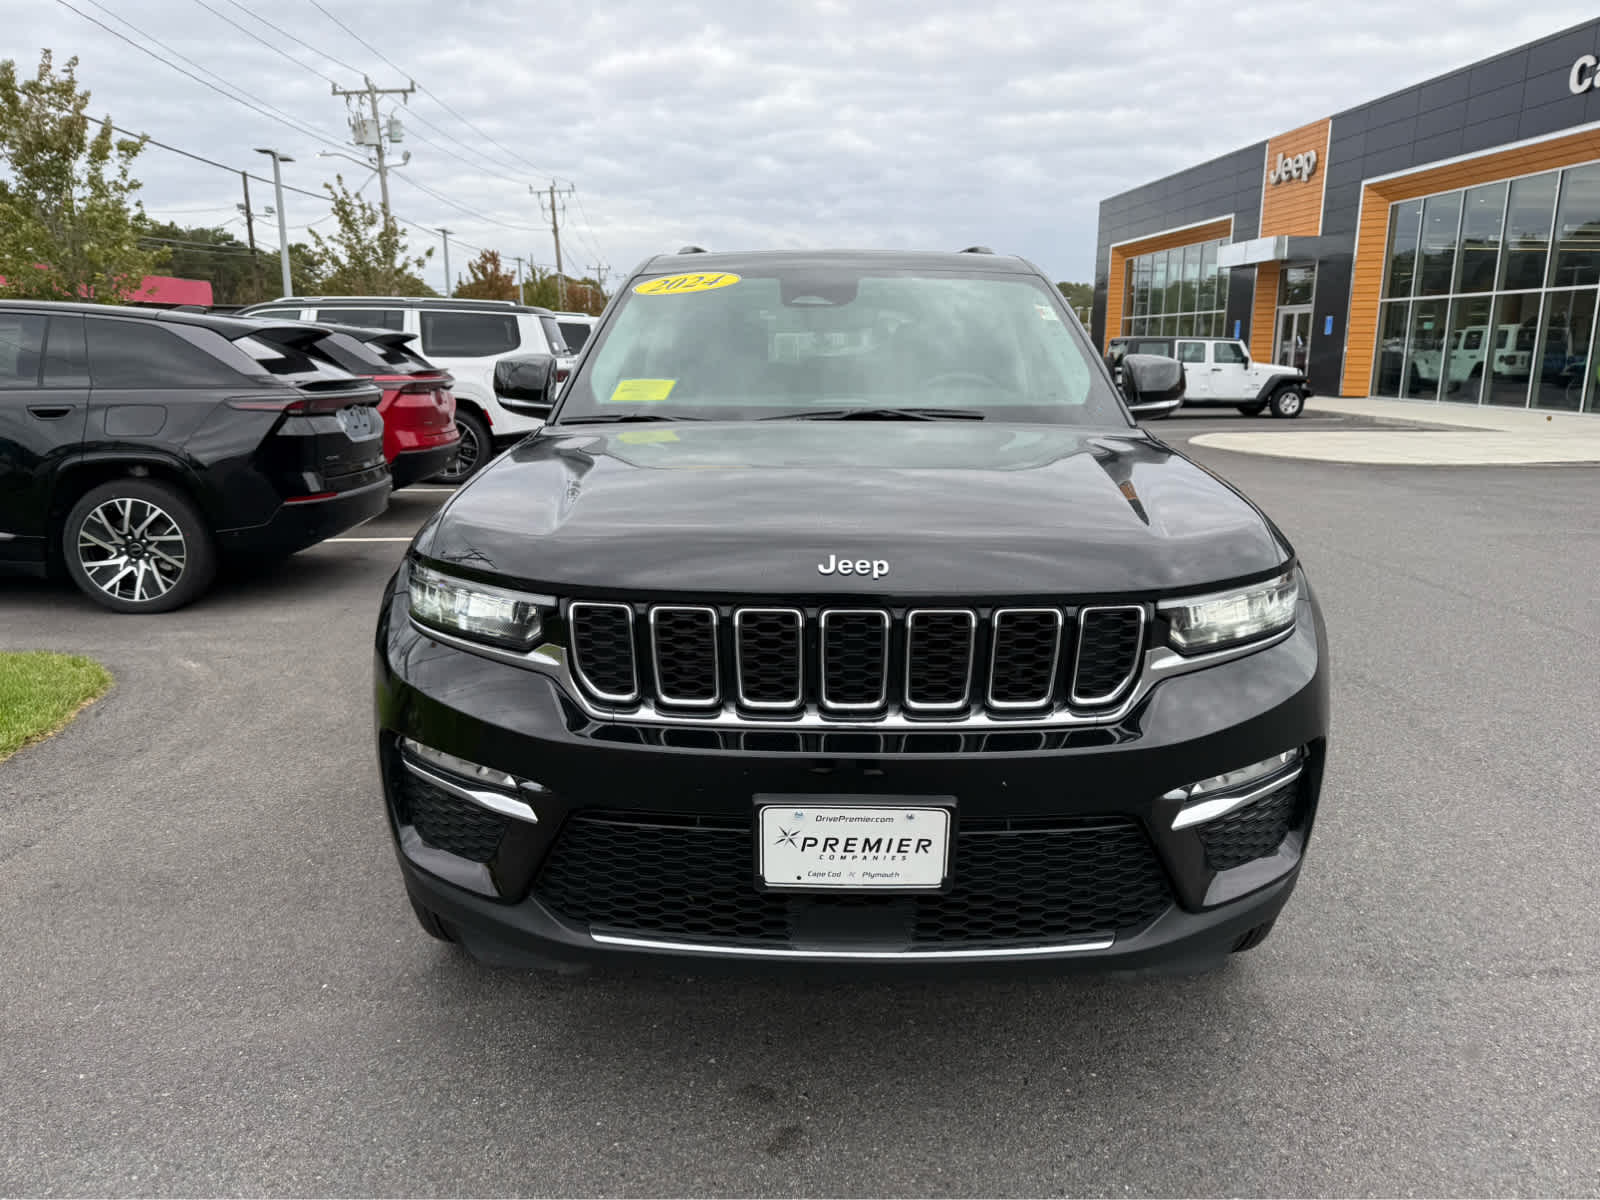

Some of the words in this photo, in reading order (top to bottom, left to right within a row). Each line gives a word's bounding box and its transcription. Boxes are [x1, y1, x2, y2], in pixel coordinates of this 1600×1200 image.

[1269, 149, 1317, 185] Jeep
[646, 273, 727, 292] 2024
[817, 554, 890, 580] Jeep
[815, 815, 895, 823] DrivePremier.com
[801, 837, 933, 854] PREMIER
